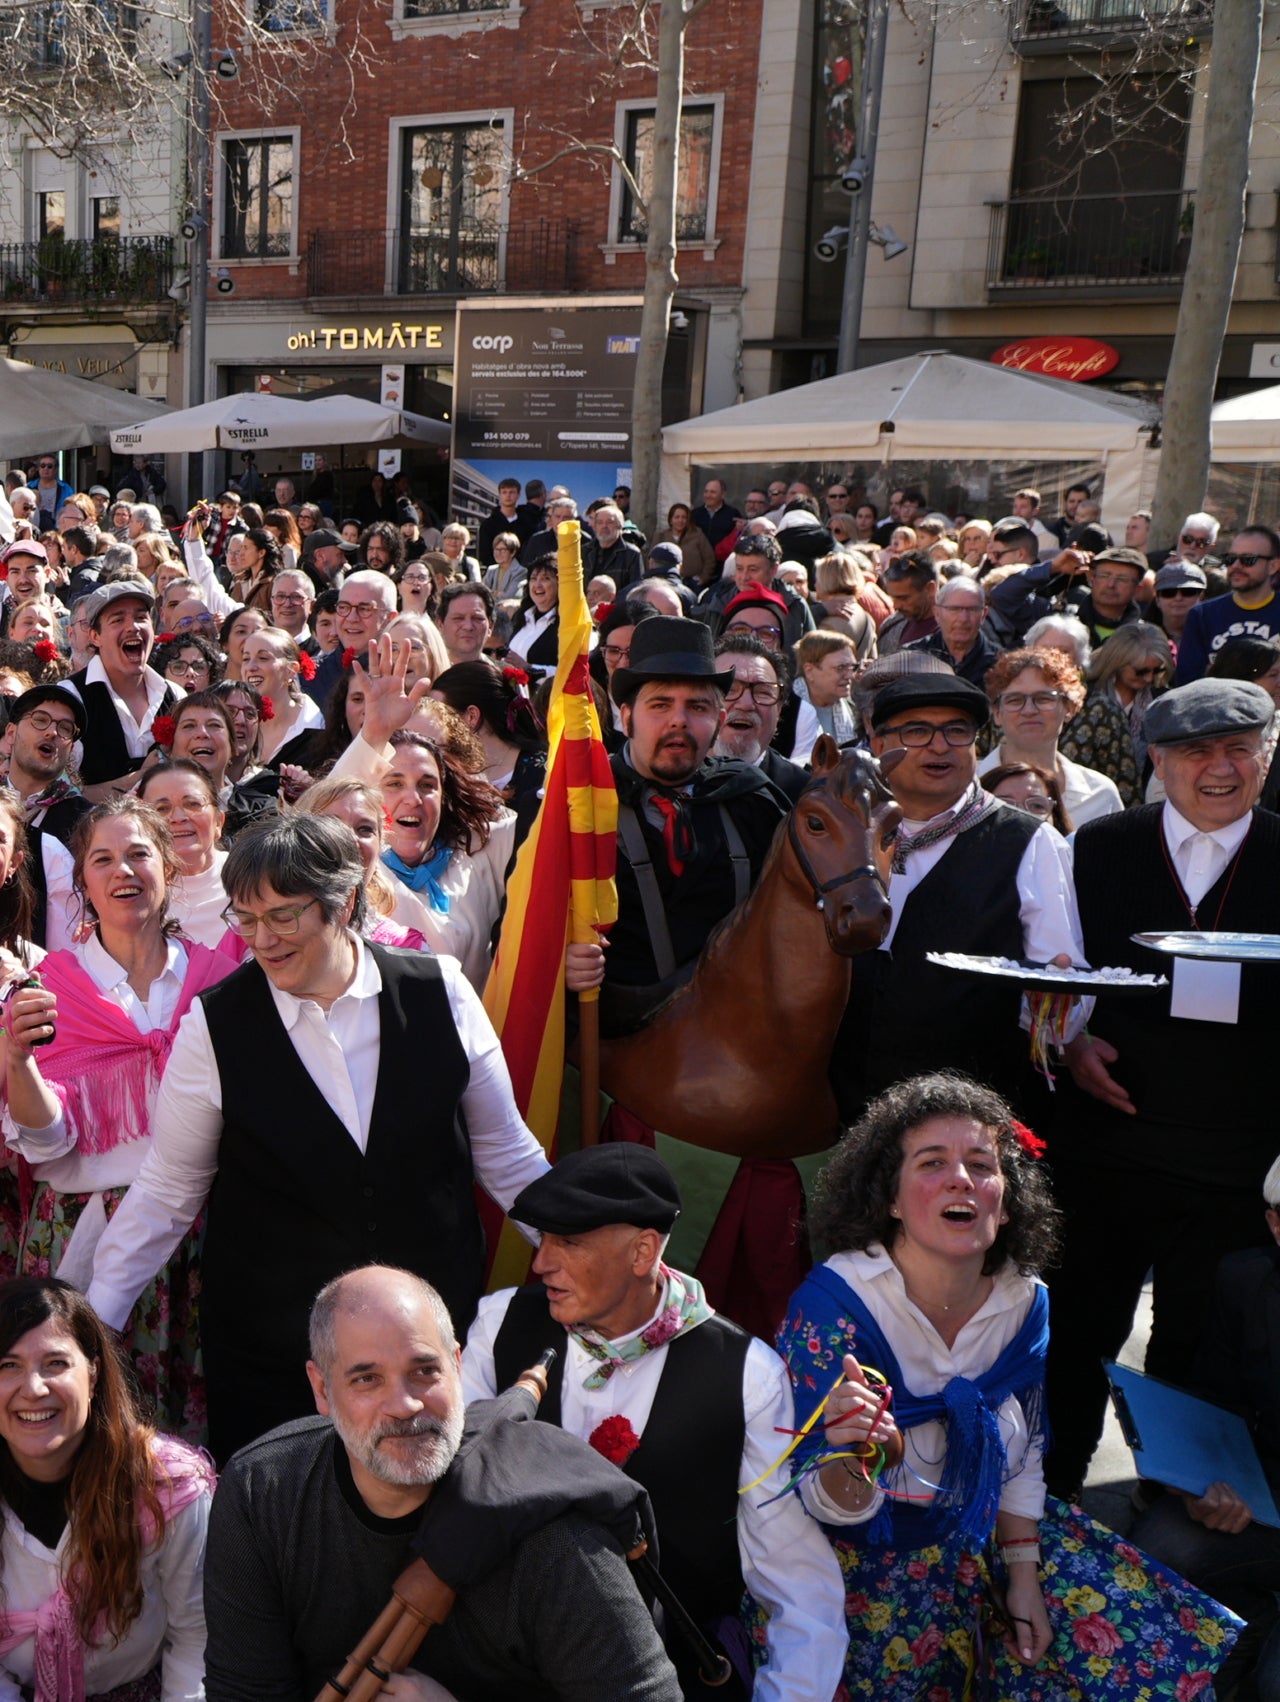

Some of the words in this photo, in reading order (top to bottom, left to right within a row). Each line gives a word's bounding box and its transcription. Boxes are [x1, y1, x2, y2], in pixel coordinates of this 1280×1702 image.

[287, 329, 317, 350] oh!
[472, 335, 514, 354] corp
[551, 341, 584, 350] Terrassa
[77, 356, 125, 374] VELLA
[472, 363, 507, 371] Habitatges
[550, 362, 566, 370] amb
[1040, 345, 1107, 379] Confit
[115, 434, 142, 443] ESTRELLA
[228, 428, 269, 439] ESTRELLA
[483, 432, 498, 440] 934
[499, 432, 514, 440] 100
[515, 432, 530, 440] 079
